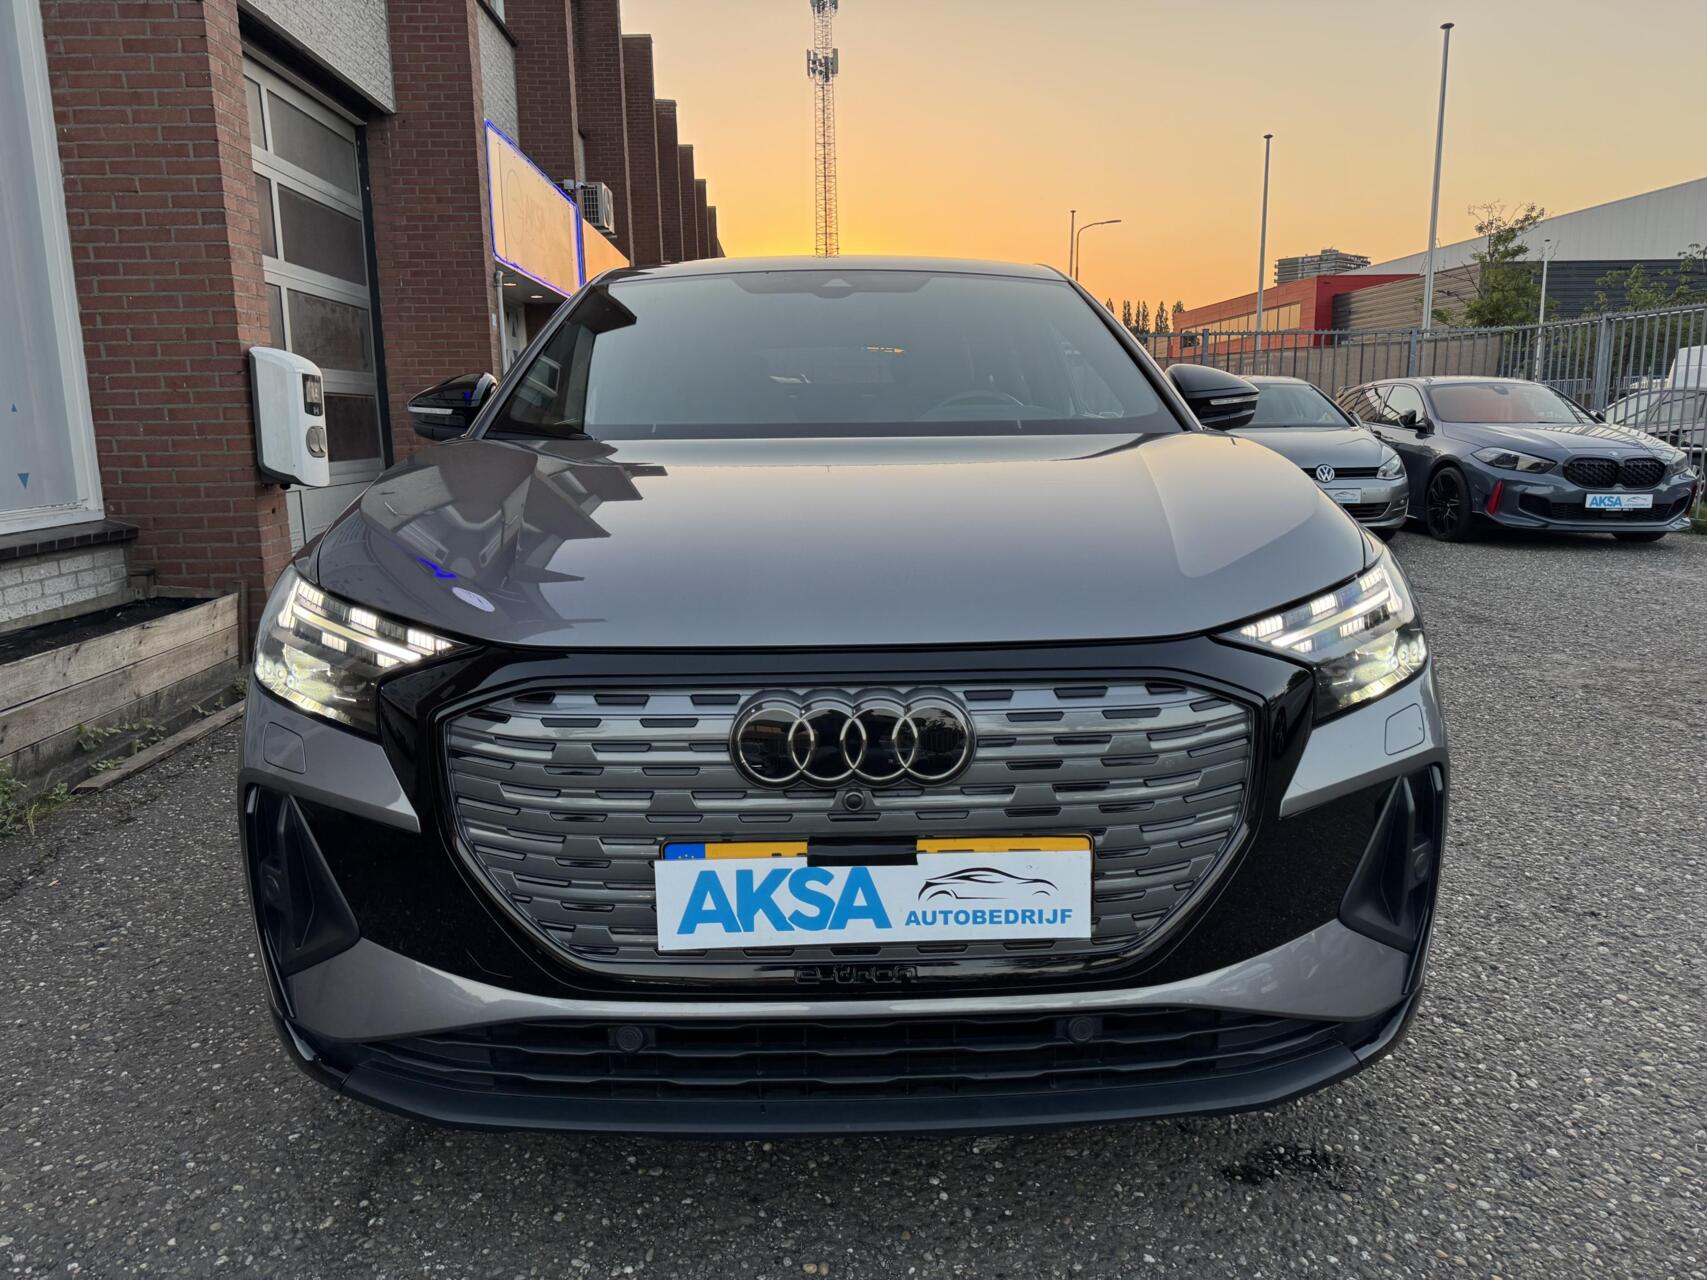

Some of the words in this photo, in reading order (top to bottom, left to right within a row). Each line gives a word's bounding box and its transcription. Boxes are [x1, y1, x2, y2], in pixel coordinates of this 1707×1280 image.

[1590, 496, 1622, 507] AKSA
[677, 866, 892, 934] AKSA
[905, 909, 1073, 926] AUTOBEDRIJF
